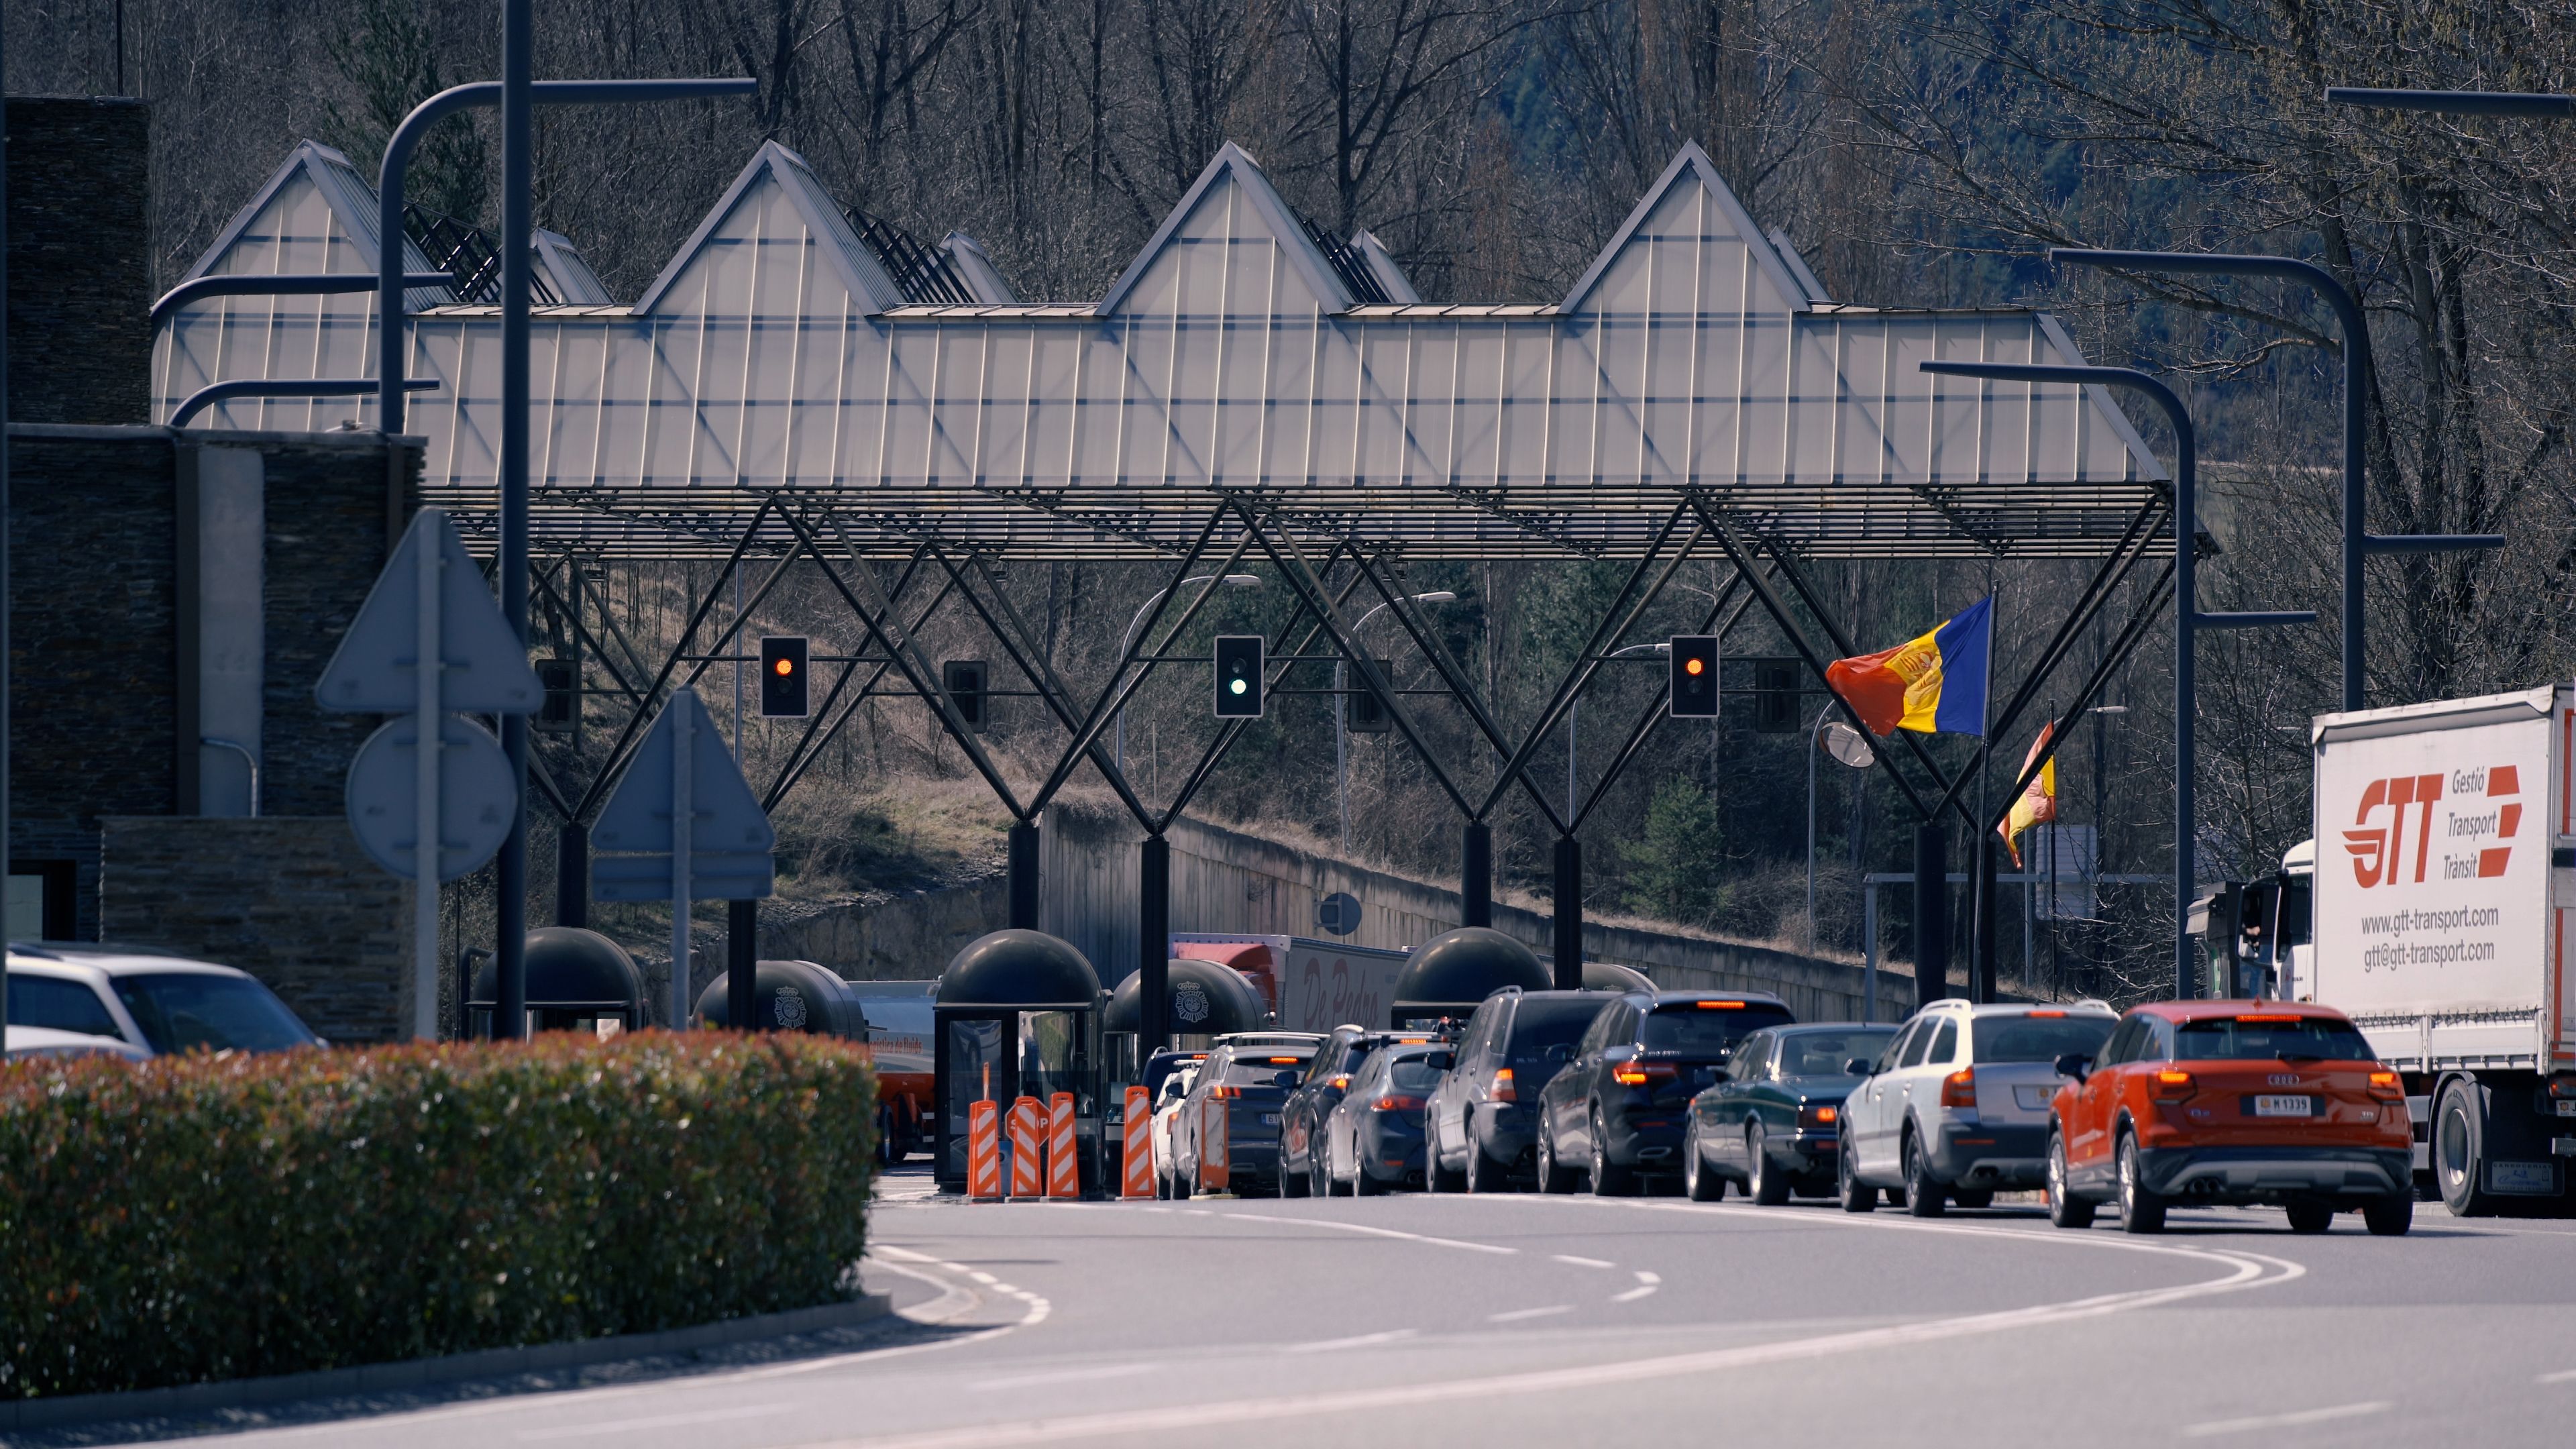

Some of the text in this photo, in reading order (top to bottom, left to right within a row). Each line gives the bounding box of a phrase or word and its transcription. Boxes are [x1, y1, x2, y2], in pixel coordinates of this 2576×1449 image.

[2452, 765, 2485, 794] Gestió
[2341, 773, 2445, 888] GTT
[2448, 810, 2497, 842] Transport
[2444, 853, 2477, 880] Trànsit
[2361, 904, 2499, 938] www.gtt-transport.com
[2364, 938, 2495, 973] gtt@gtt-transport.com
[1303, 957, 1379, 1032] De Pedro
[869, 1036, 894, 1053] ogística
[2273, 1097, 2308, 1111] M 1339
[1010, 1117, 1049, 1130] SP
